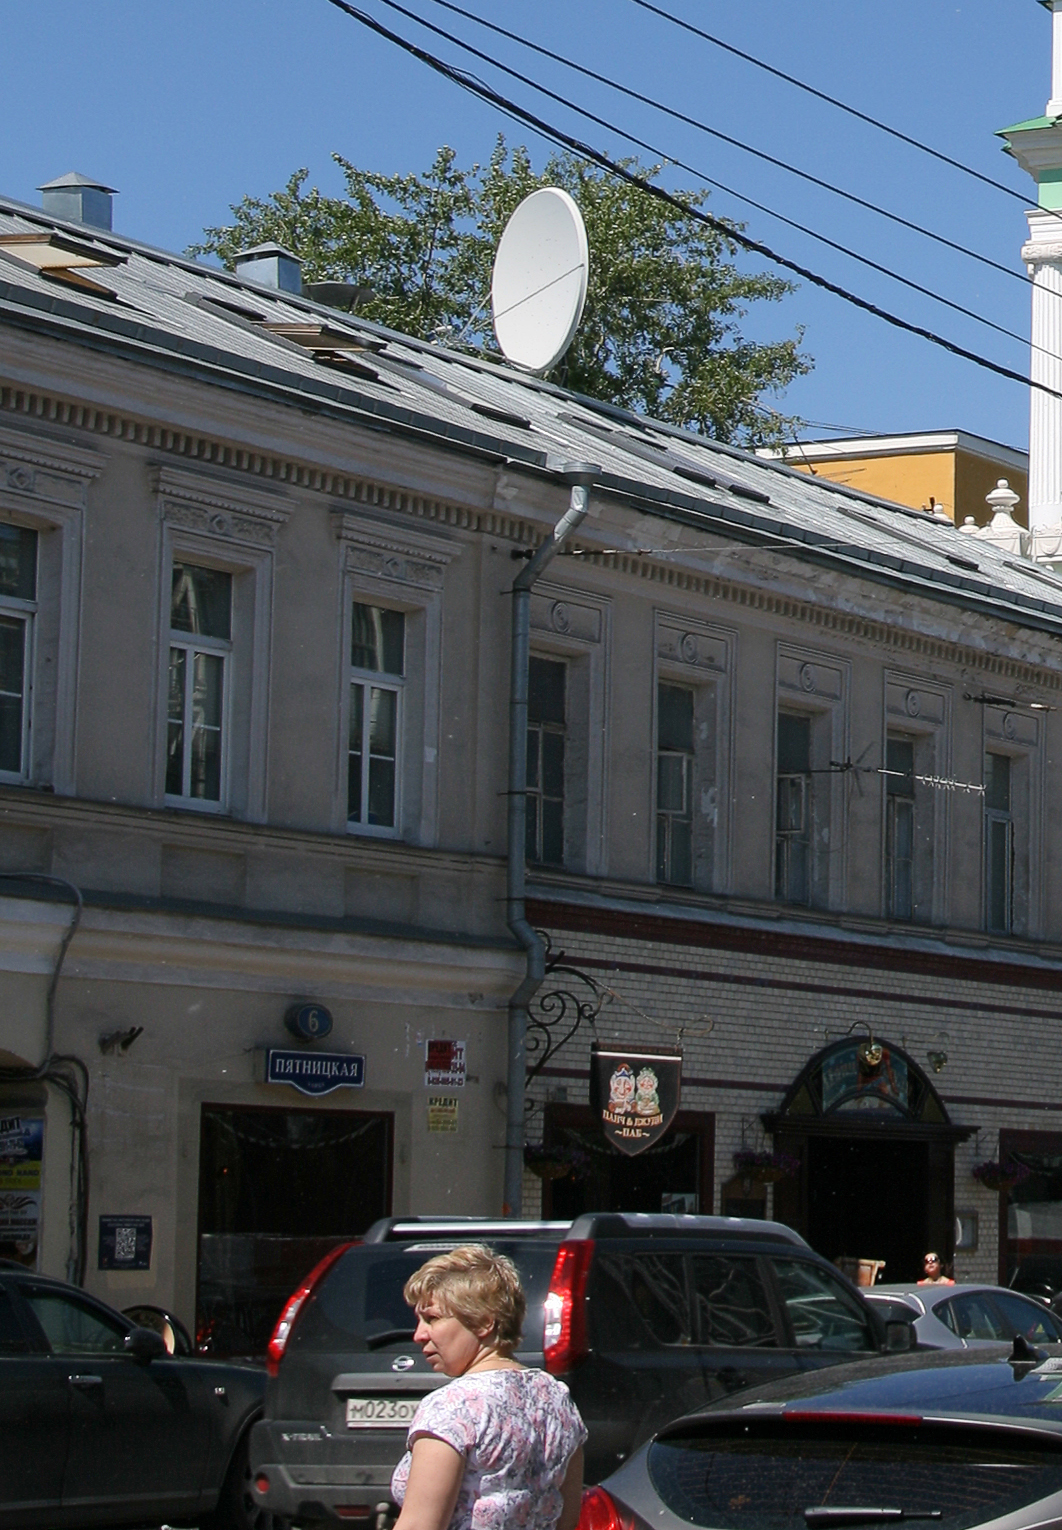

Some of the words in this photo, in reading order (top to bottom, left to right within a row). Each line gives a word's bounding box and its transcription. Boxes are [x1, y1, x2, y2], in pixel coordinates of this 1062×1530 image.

[308, 1010, 319, 1032] 6
[275, 1058, 358, 1078] ПЯТНИЦКАЯ
[429, 1097, 457, 1107] КРЕДИТ
[602, 1109, 626, 1125] ПАНЧ
[623, 1127, 642, 1137] ПАБ
